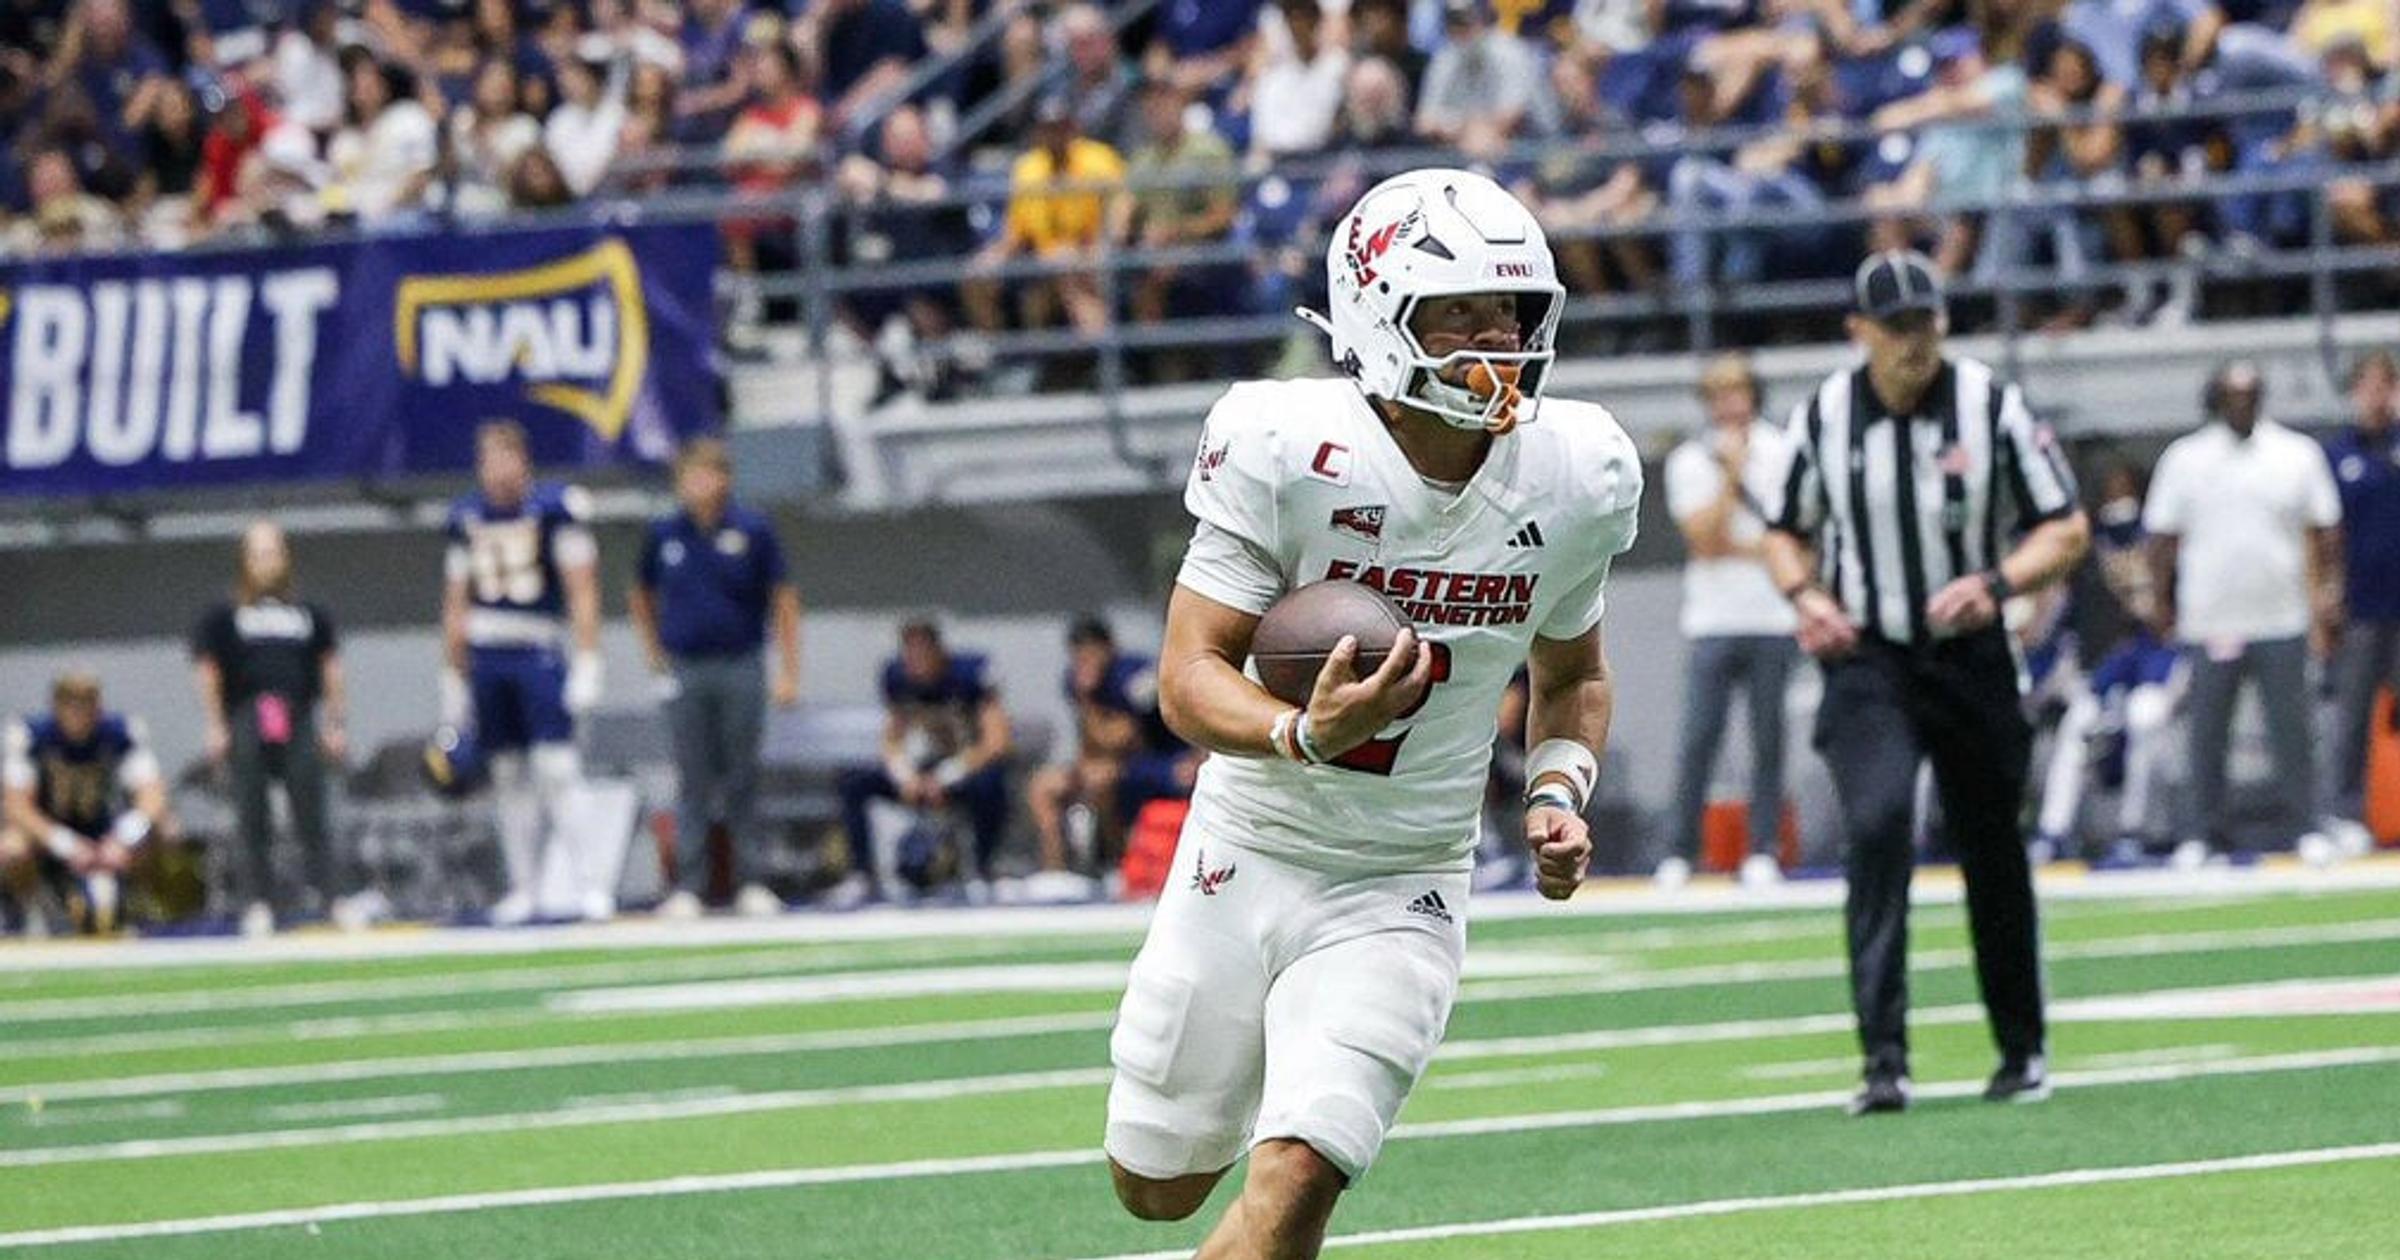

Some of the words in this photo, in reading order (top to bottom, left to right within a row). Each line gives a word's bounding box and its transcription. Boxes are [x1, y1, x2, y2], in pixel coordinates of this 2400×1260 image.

[1495, 263, 1533, 278] EWU
[422, 299, 614, 387] NAU
[6, 266, 339, 470] BUILT
[1311, 441, 1349, 478] C
[1325, 559, 1540, 604] EASTERN
[1396, 599, 1532, 627] HINGTON
